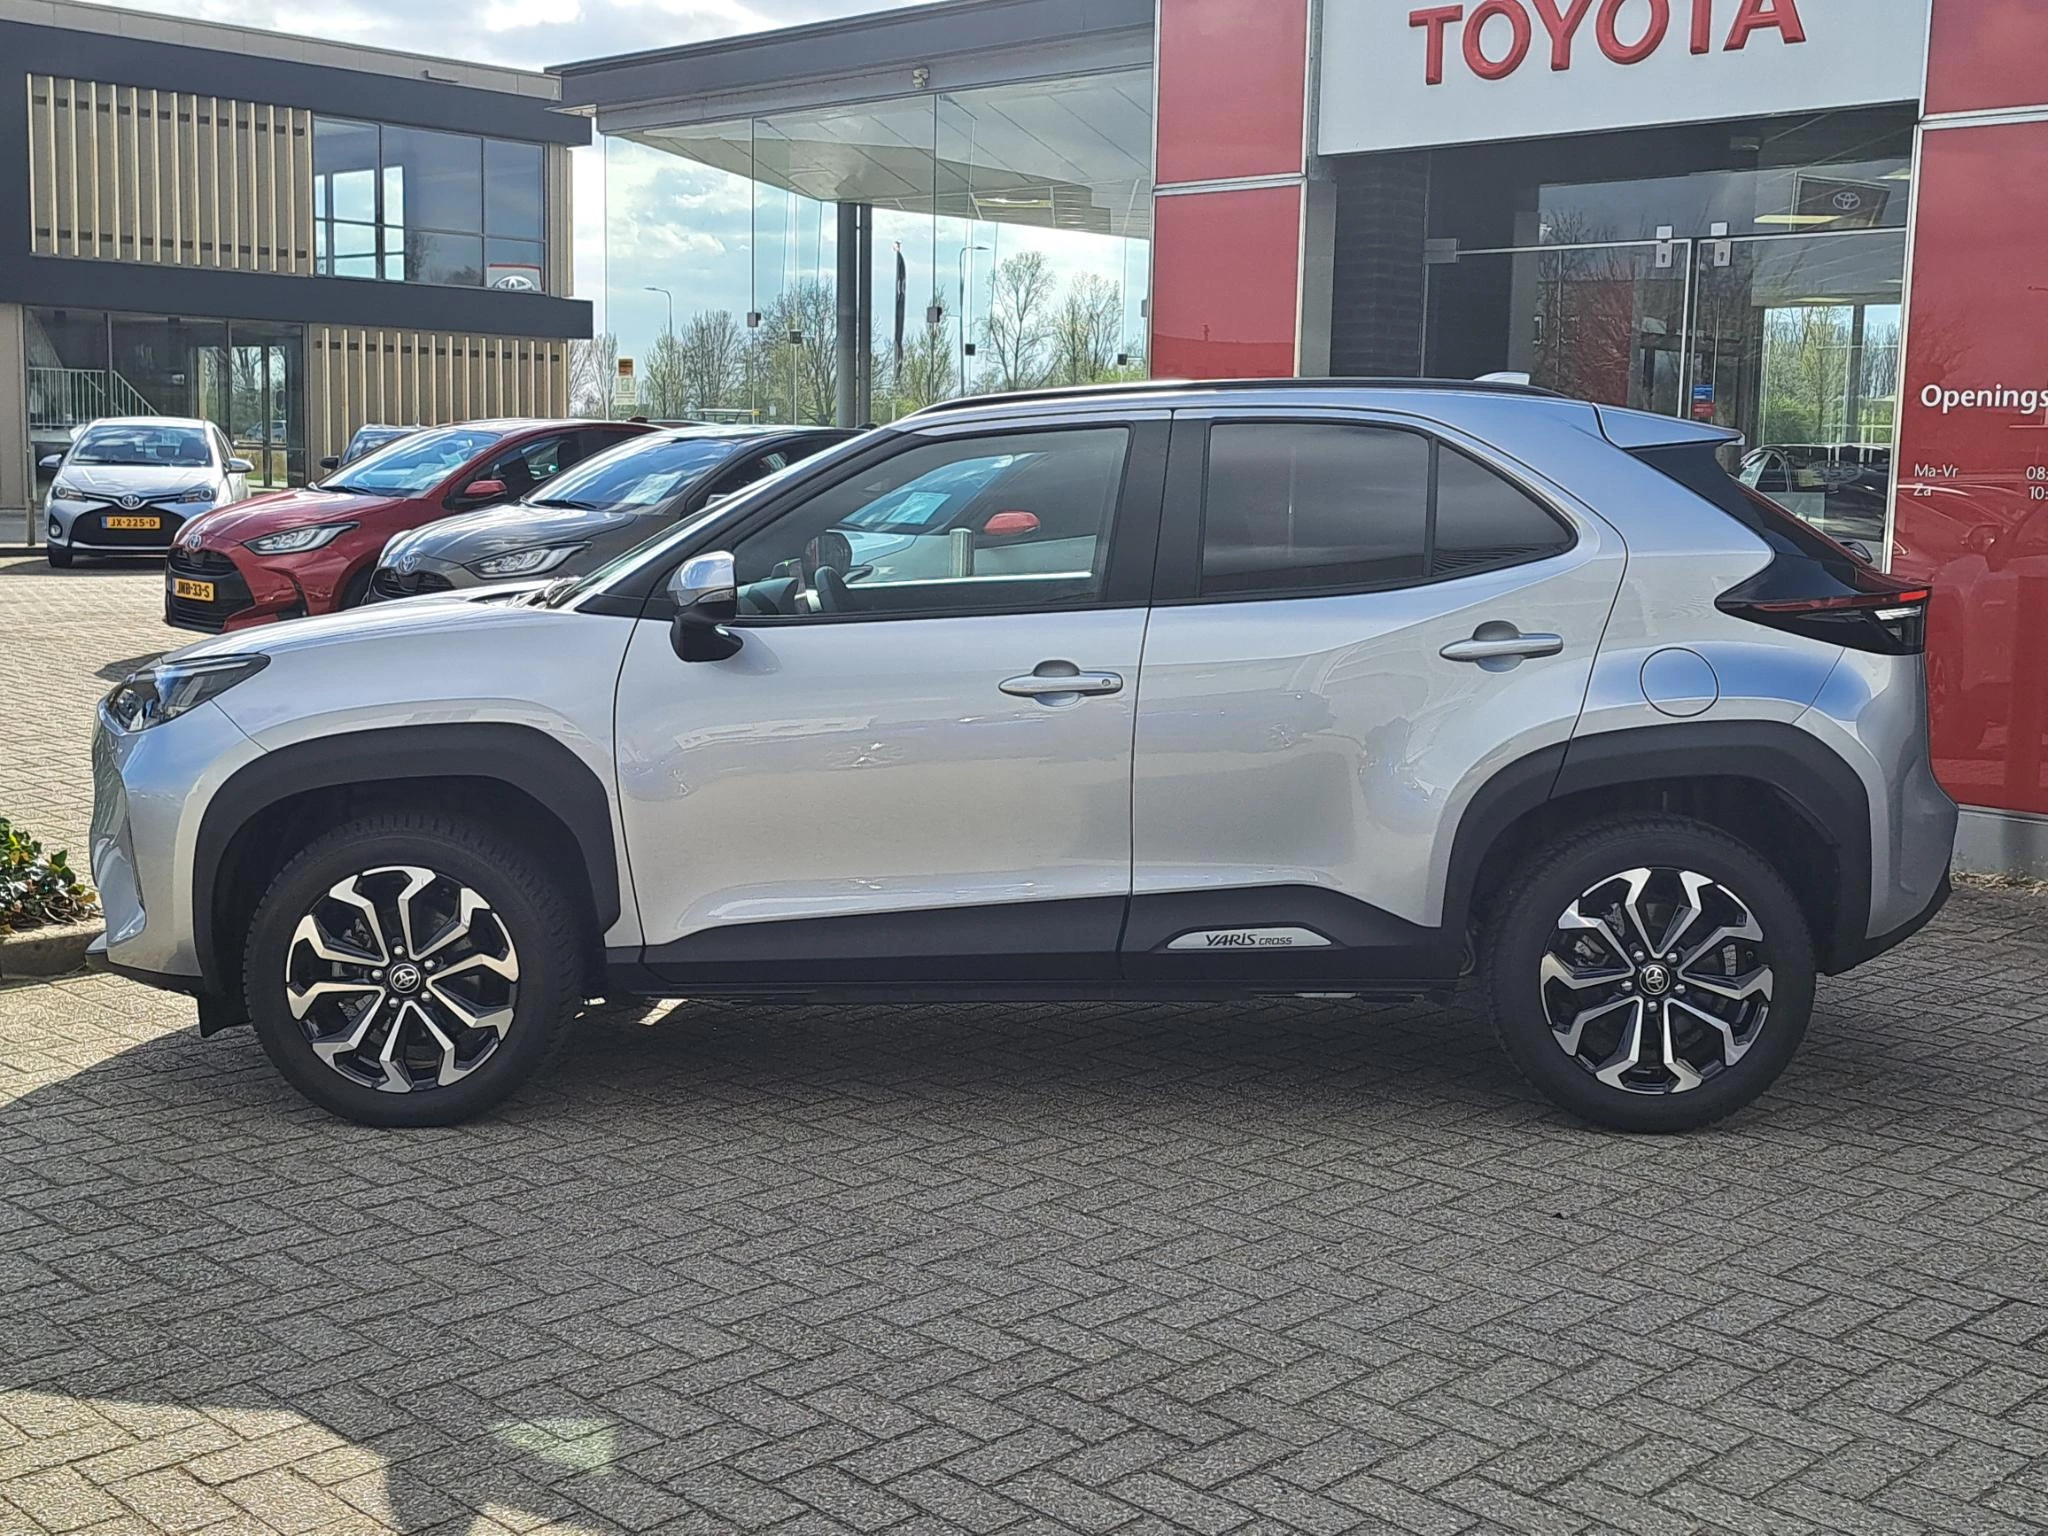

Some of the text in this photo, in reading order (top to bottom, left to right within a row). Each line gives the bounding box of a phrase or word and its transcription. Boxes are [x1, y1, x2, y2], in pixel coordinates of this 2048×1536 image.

[1914, 463, 1959, 478] Ma-Vr
[1913, 483, 1932, 496] Za
[111, 518, 156, 528] JX-225-D
[1205, 932, 1292, 946] YARIS CROSS
